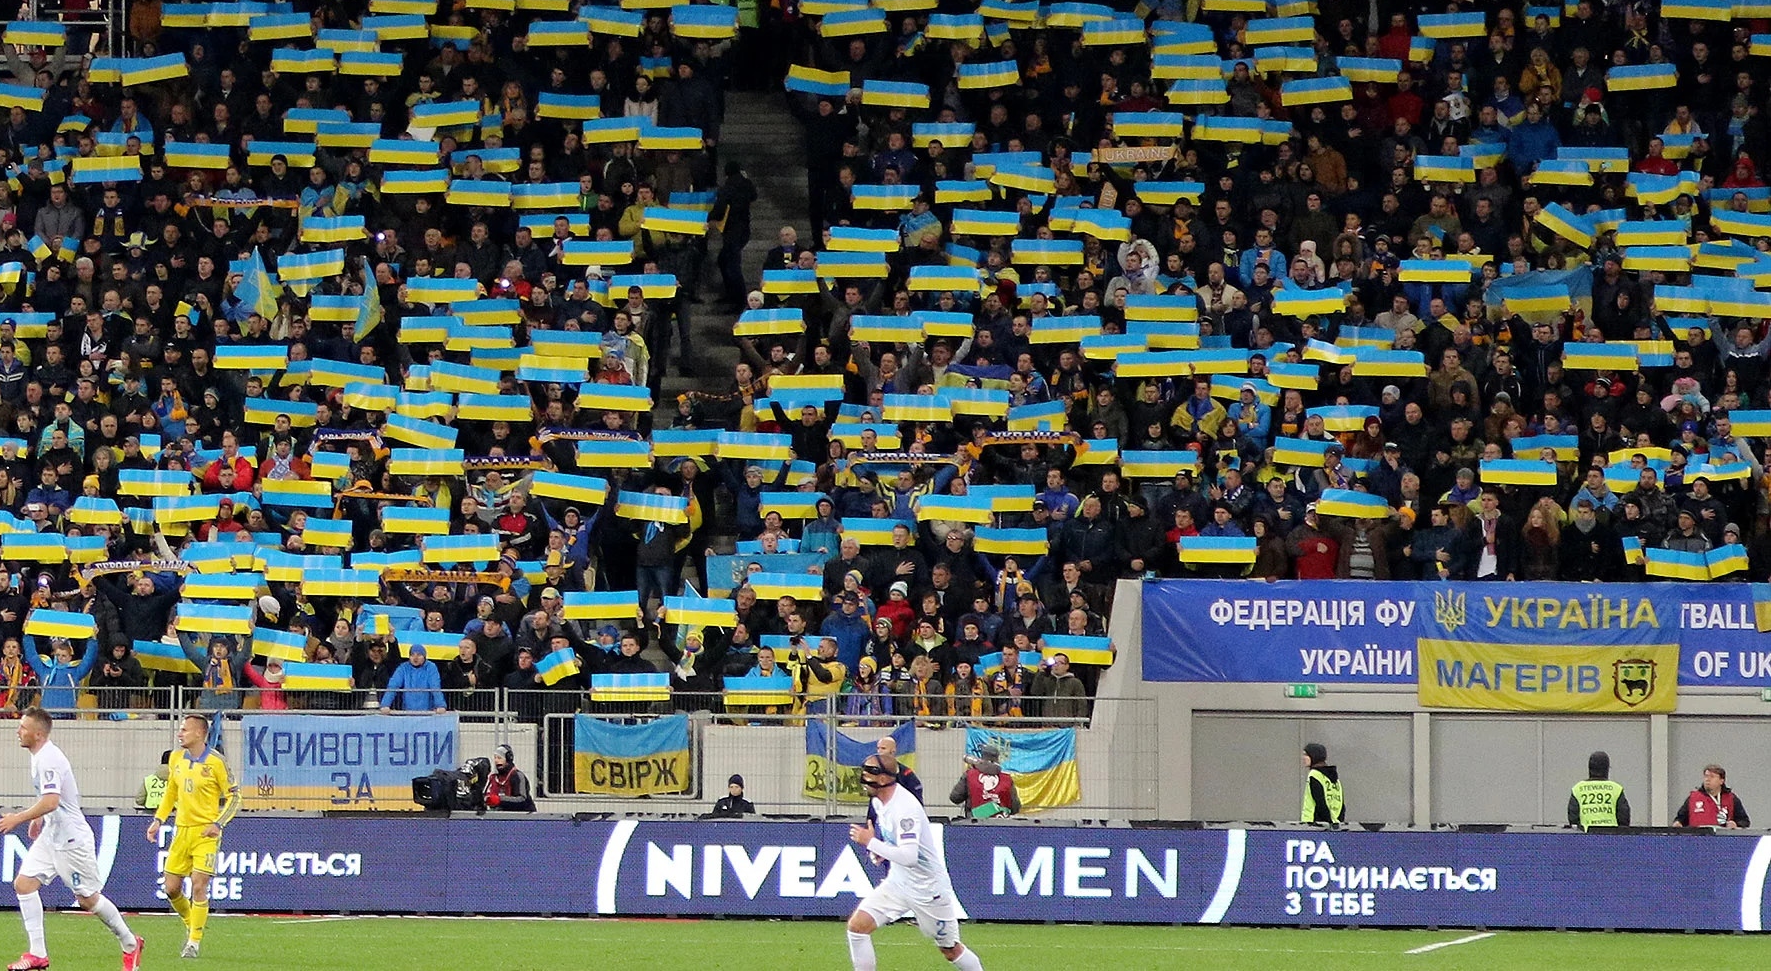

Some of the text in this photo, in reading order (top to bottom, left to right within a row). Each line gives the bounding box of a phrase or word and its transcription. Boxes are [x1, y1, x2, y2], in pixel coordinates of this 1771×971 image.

[1105, 149, 1170, 162] UKRAINE
[559, 430, 589, 439] СЛАВА
[991, 431, 1061, 439] УКРАЇНА
[863, 453, 941, 461] UKRAINE
[95, 560, 190, 571] ГЕРОЯМ СЛАВА
[1209, 599, 1365, 631] ФЕДЕРАЦІЯ
[1484, 593, 1661, 630] УКРАЇНА
[1680, 602, 1755, 630] TBALL
[1300, 643, 1413, 676] УКРАЇНИ
[1694, 650, 1730, 677] OF
[1436, 659, 1601, 694] МАГЕРІВ
[248, 724, 454, 768] КРИВОТУЛИ
[151, 778, 166, 789] 23
[589, 757, 679, 789] СВІРЖ
[330, 771, 376, 805] ЗА
[1579, 784, 1614, 792] STEWARD
[1580, 793, 1613, 805] 2292
[1581, 807, 1613, 815] СТЮАРД
[157, 851, 362, 877] ПИНАЄТЬСЯ
[1285, 839, 1335, 864] ГРА
[71, 871, 81, 886] 8
[645, 840, 876, 901] NIVEA
[991, 845, 1179, 899] MEN
[1285, 865, 1497, 892] ПОЧИНАЄТЬСЯ
[1285, 892, 1375, 916] З ТЕБЕ
[936, 920, 947, 936] 2
